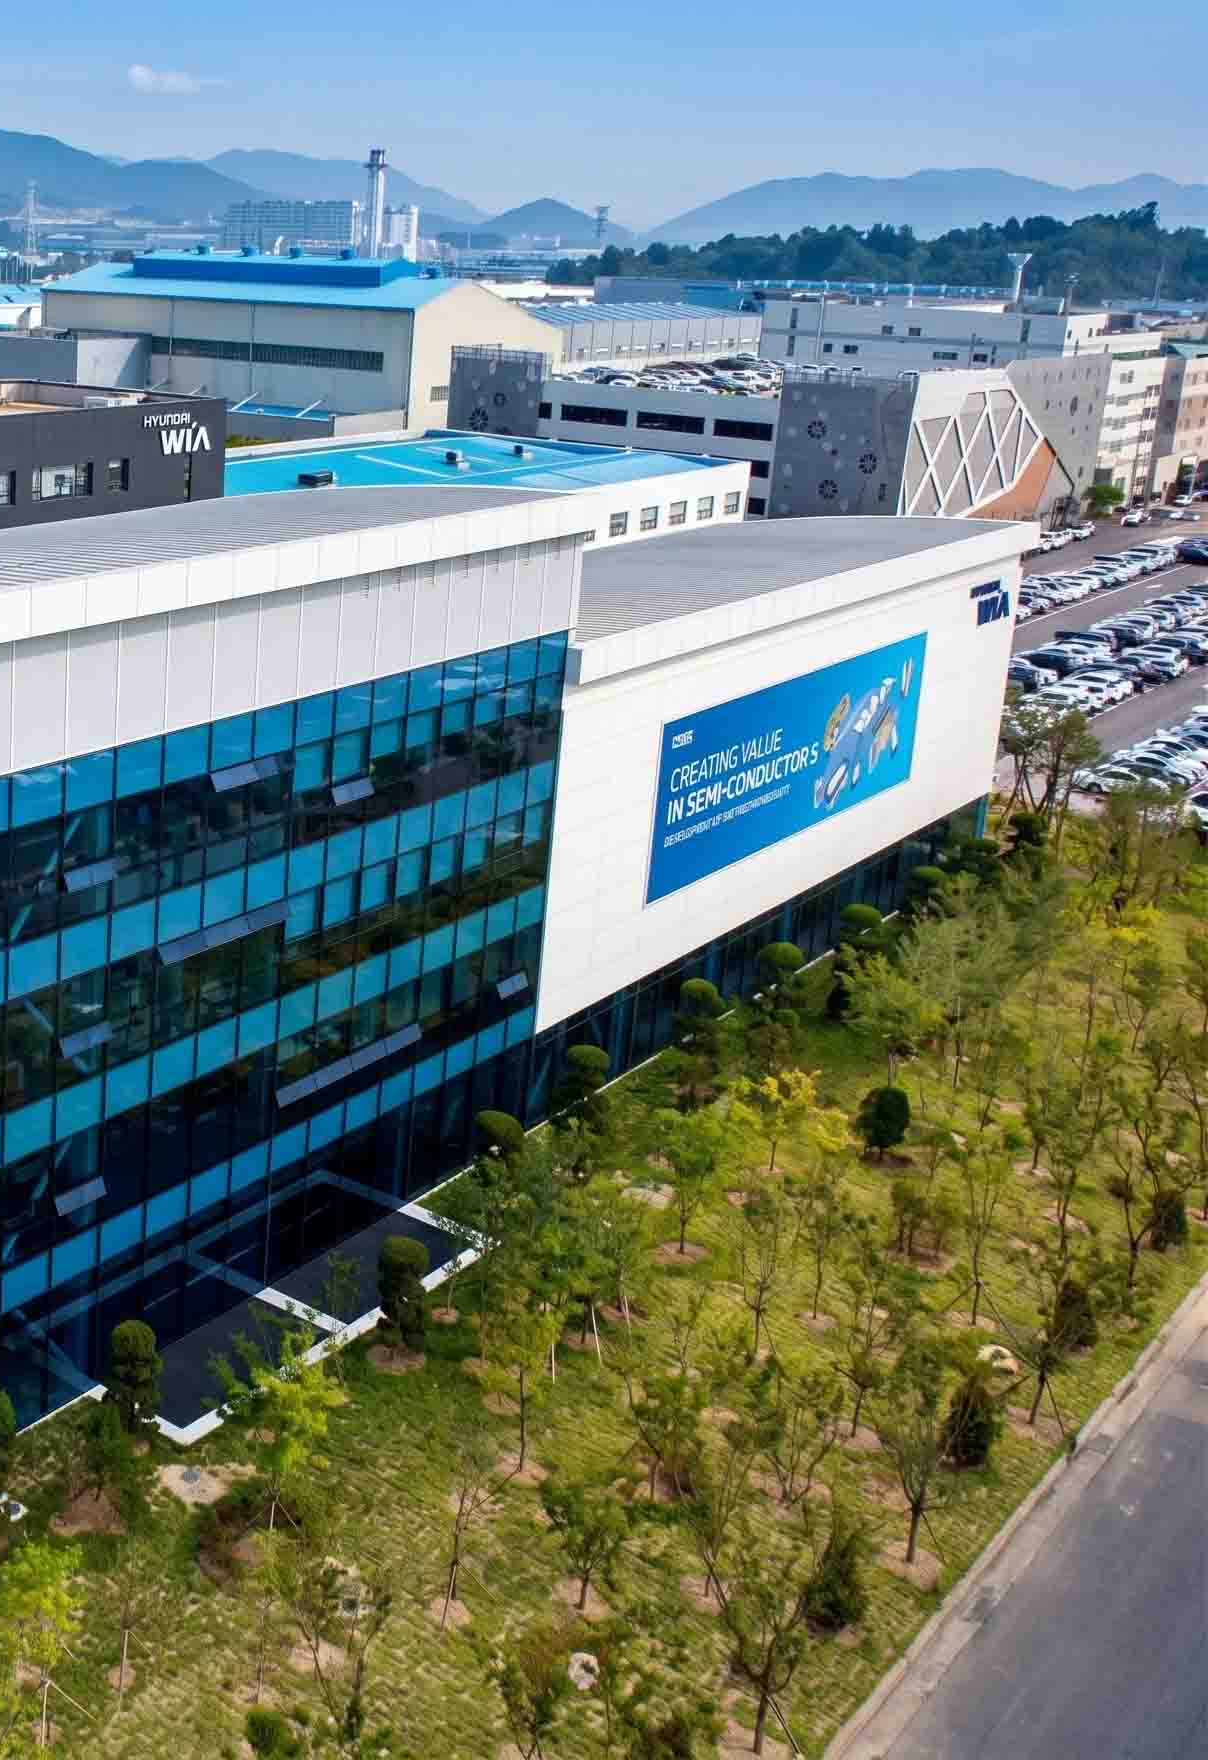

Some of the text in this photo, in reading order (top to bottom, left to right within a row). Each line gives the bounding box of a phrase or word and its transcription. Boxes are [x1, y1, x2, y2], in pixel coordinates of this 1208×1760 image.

[144, 413, 190, 428] HYUNDAI
[161, 422, 211, 455] WIA
[670, 745, 738, 793] CREATING
[742, 728, 783, 764] VALUE
[667, 796, 685, 825] IN
